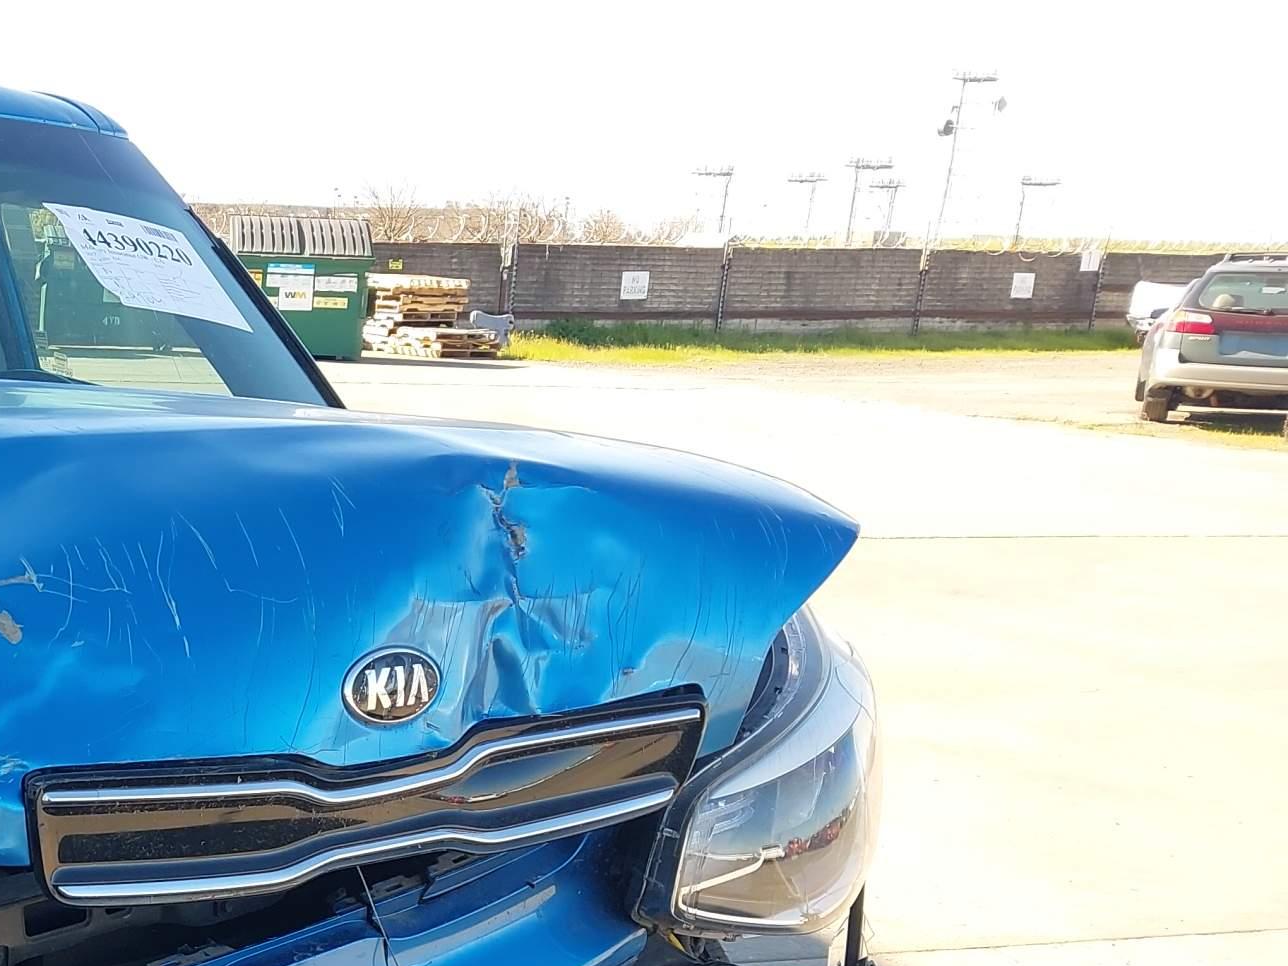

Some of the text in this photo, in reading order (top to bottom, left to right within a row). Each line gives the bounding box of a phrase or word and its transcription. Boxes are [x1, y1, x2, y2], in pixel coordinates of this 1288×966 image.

[82, 227, 192, 266] 44390220
[284, 291, 306, 299] WM
[364, 663, 429, 711] KIA
